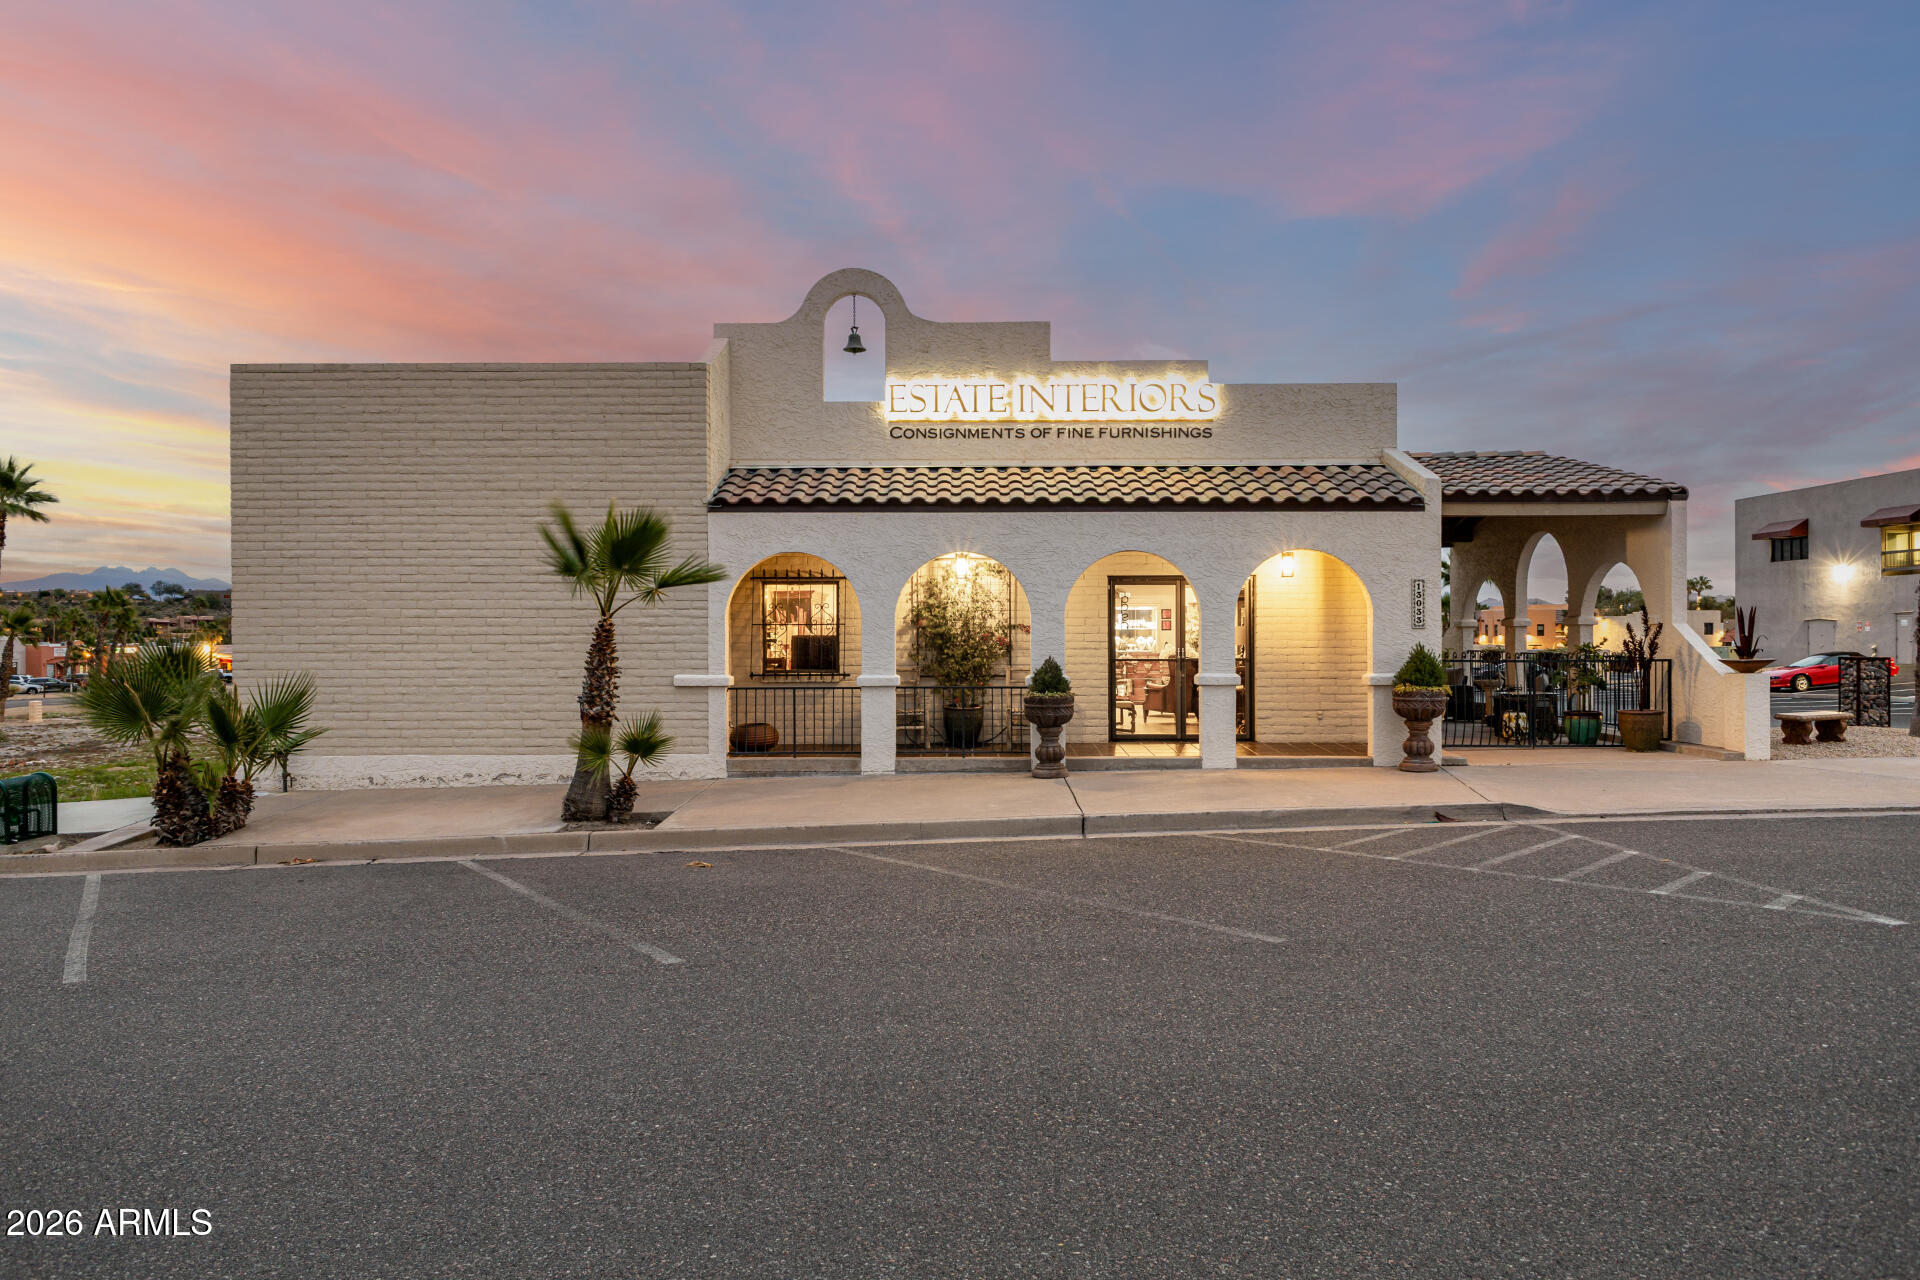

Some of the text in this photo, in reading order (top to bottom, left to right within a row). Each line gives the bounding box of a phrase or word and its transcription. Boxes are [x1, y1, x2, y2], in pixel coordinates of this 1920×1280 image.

[888, 383, 1216, 413] ESTATE INTERIORS
[889, 426, 1213, 439] CONSIGNMENTS OF FINE FURNISHINGS
